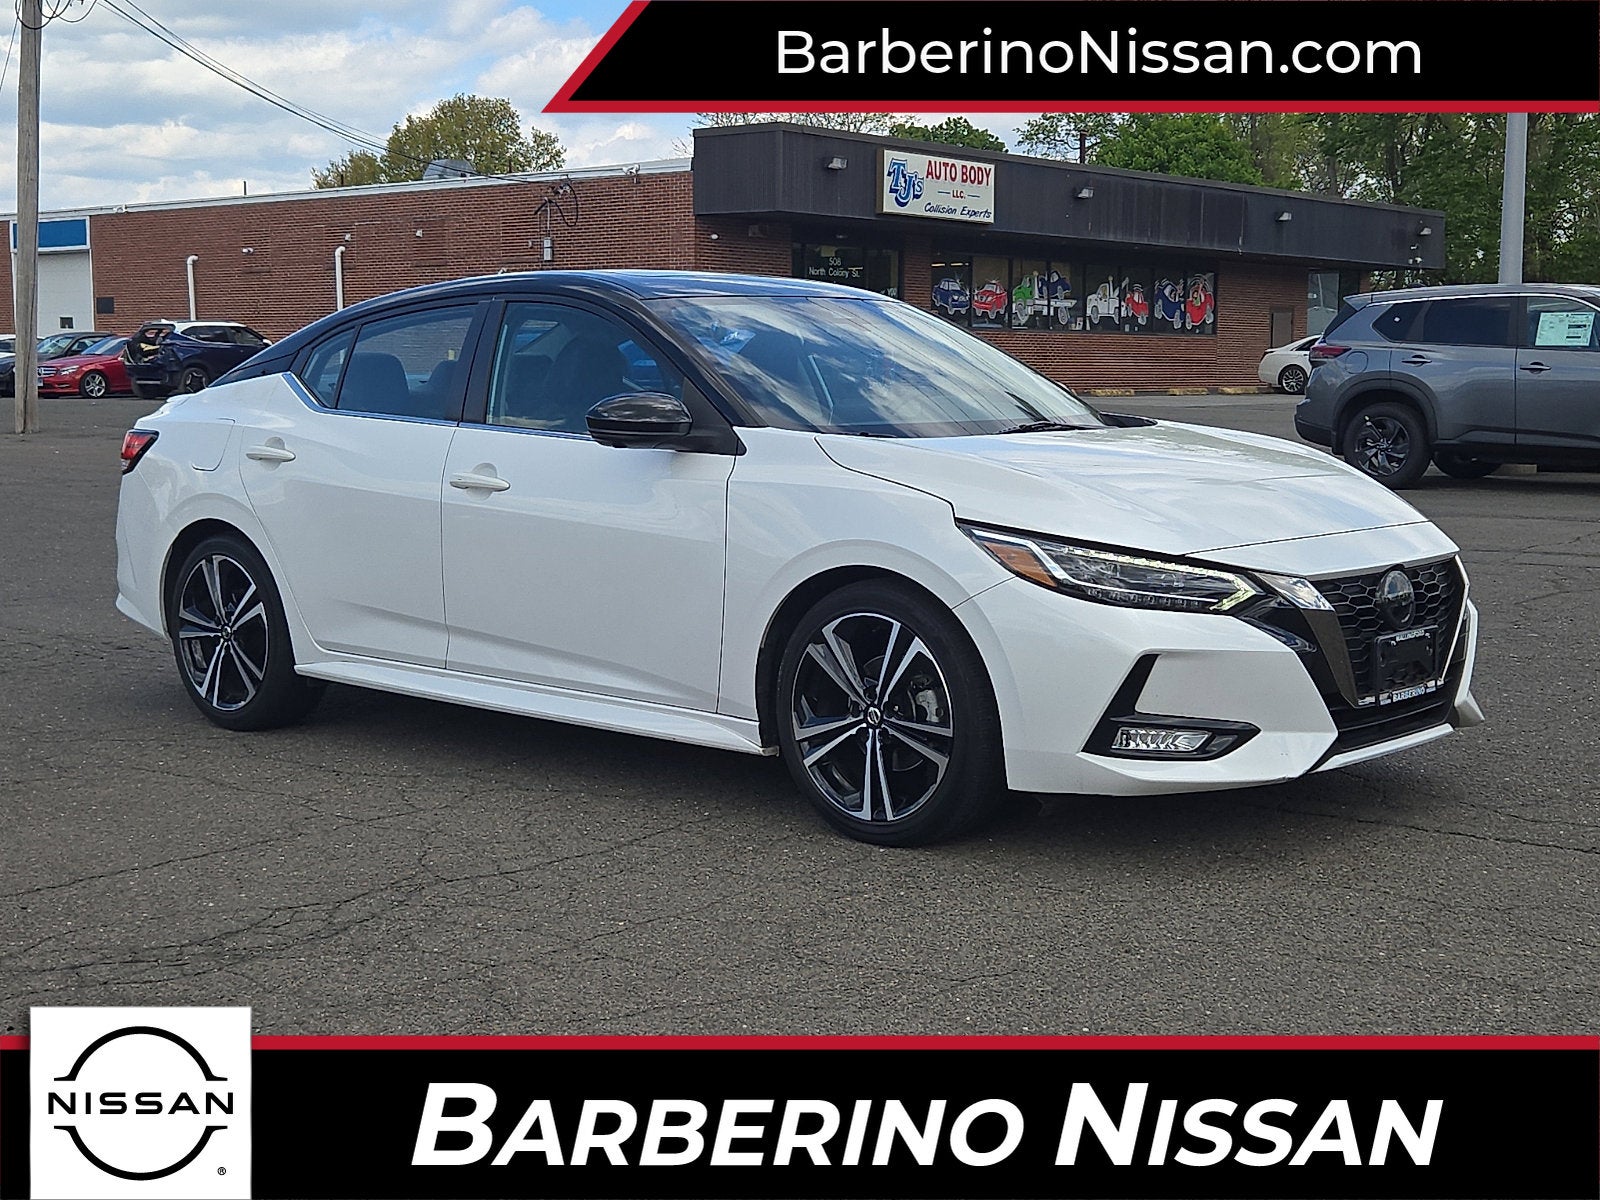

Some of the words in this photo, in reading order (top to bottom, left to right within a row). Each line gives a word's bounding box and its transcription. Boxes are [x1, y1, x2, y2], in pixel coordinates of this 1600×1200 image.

[925, 159, 958, 182] AUTO
[960, 163, 992, 187] BODY
[924, 201, 957, 216] Collision
[960, 205, 992, 219] Experts
[808, 266, 826, 276] North
[828, 267, 849, 279] Colony
[1392, 686, 1425, 702] BARBERINO
